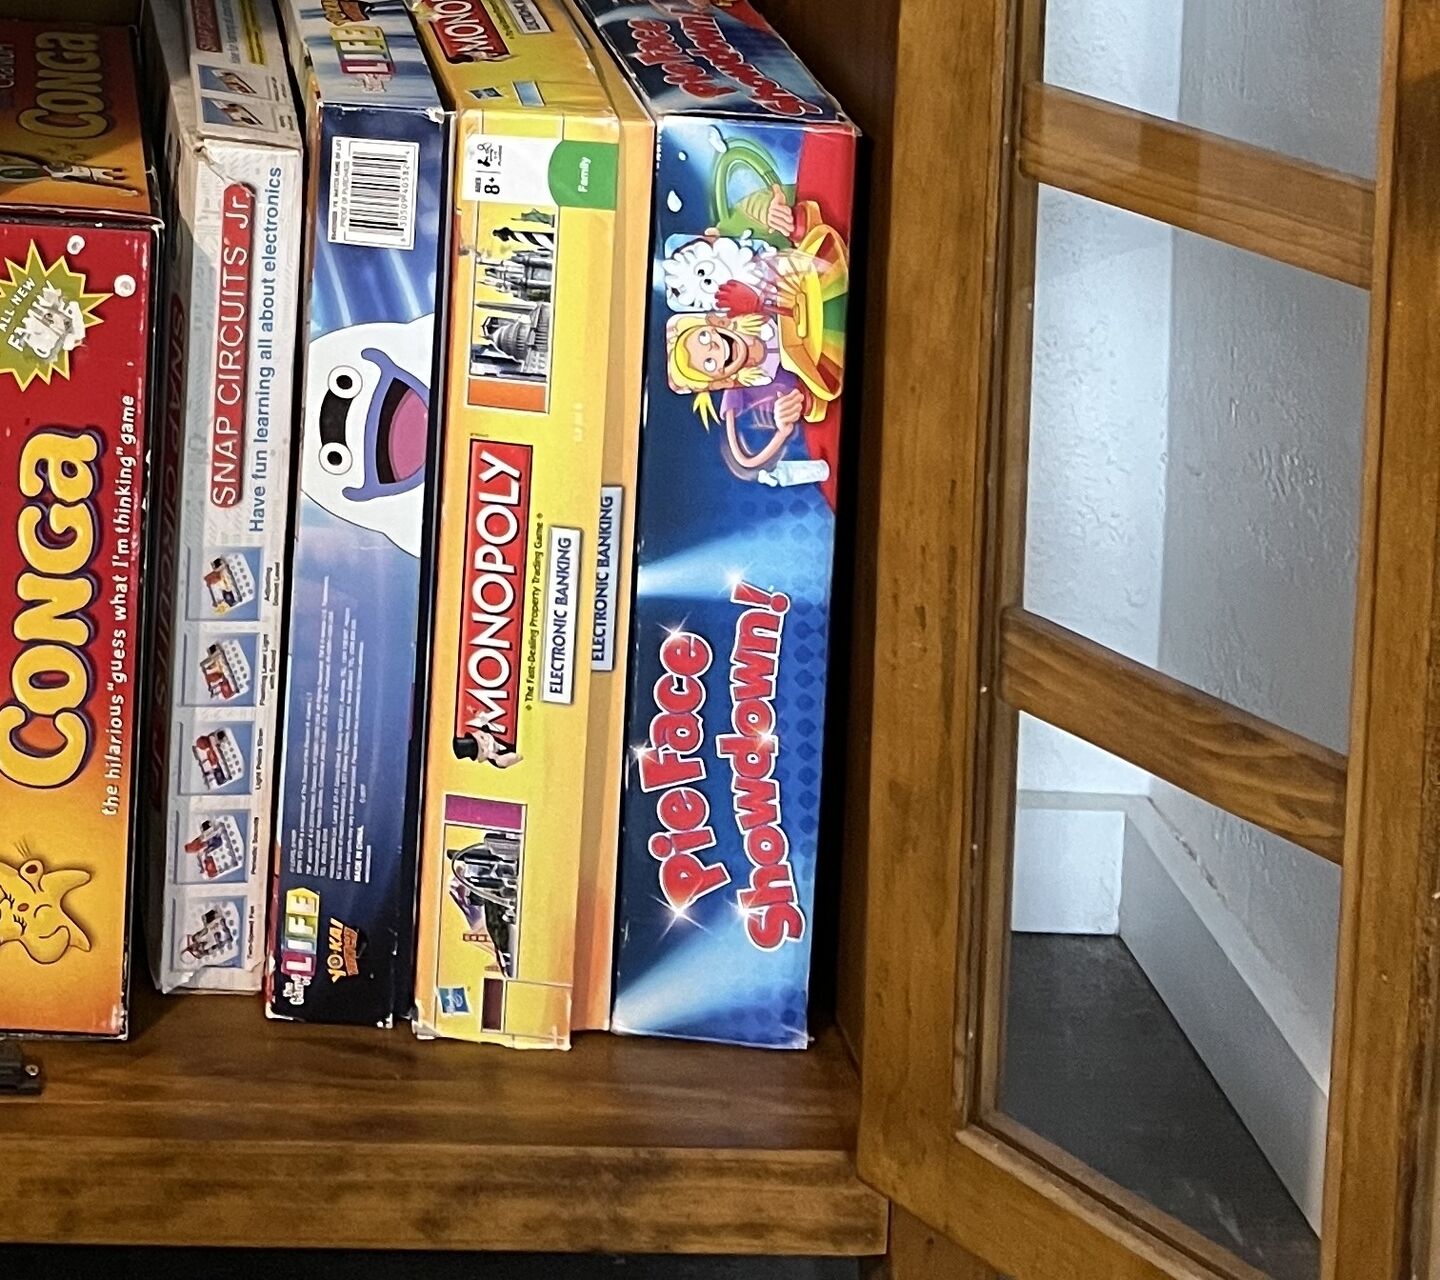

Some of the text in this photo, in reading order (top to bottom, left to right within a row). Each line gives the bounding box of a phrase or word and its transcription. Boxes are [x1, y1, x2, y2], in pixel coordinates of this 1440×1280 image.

[484, 177, 501, 196] 8+
[577, 156, 592, 193] Family
[11, 277, 37, 307] NEW
[213, 192, 252, 506] SNAP CIRCUITS Jr.
[249, 167, 283, 532] Have fun learning all about electronics
[101, 393, 137, 817] the hilarious "guess what I'm thinking" game
[465, 450, 521, 735] MONOPOLY
[525, 522, 544, 702] The Fast-Dealing Property Trading Game
[549, 537, 572, 695] ELECTRONIC BANKING
[592, 495, 614, 662] ELECTRONIC BANKING
[639, 631, 733, 906] Pie Face
[717, 581, 806, 951] Showdown!
[284, 892, 319, 974] LIFE
